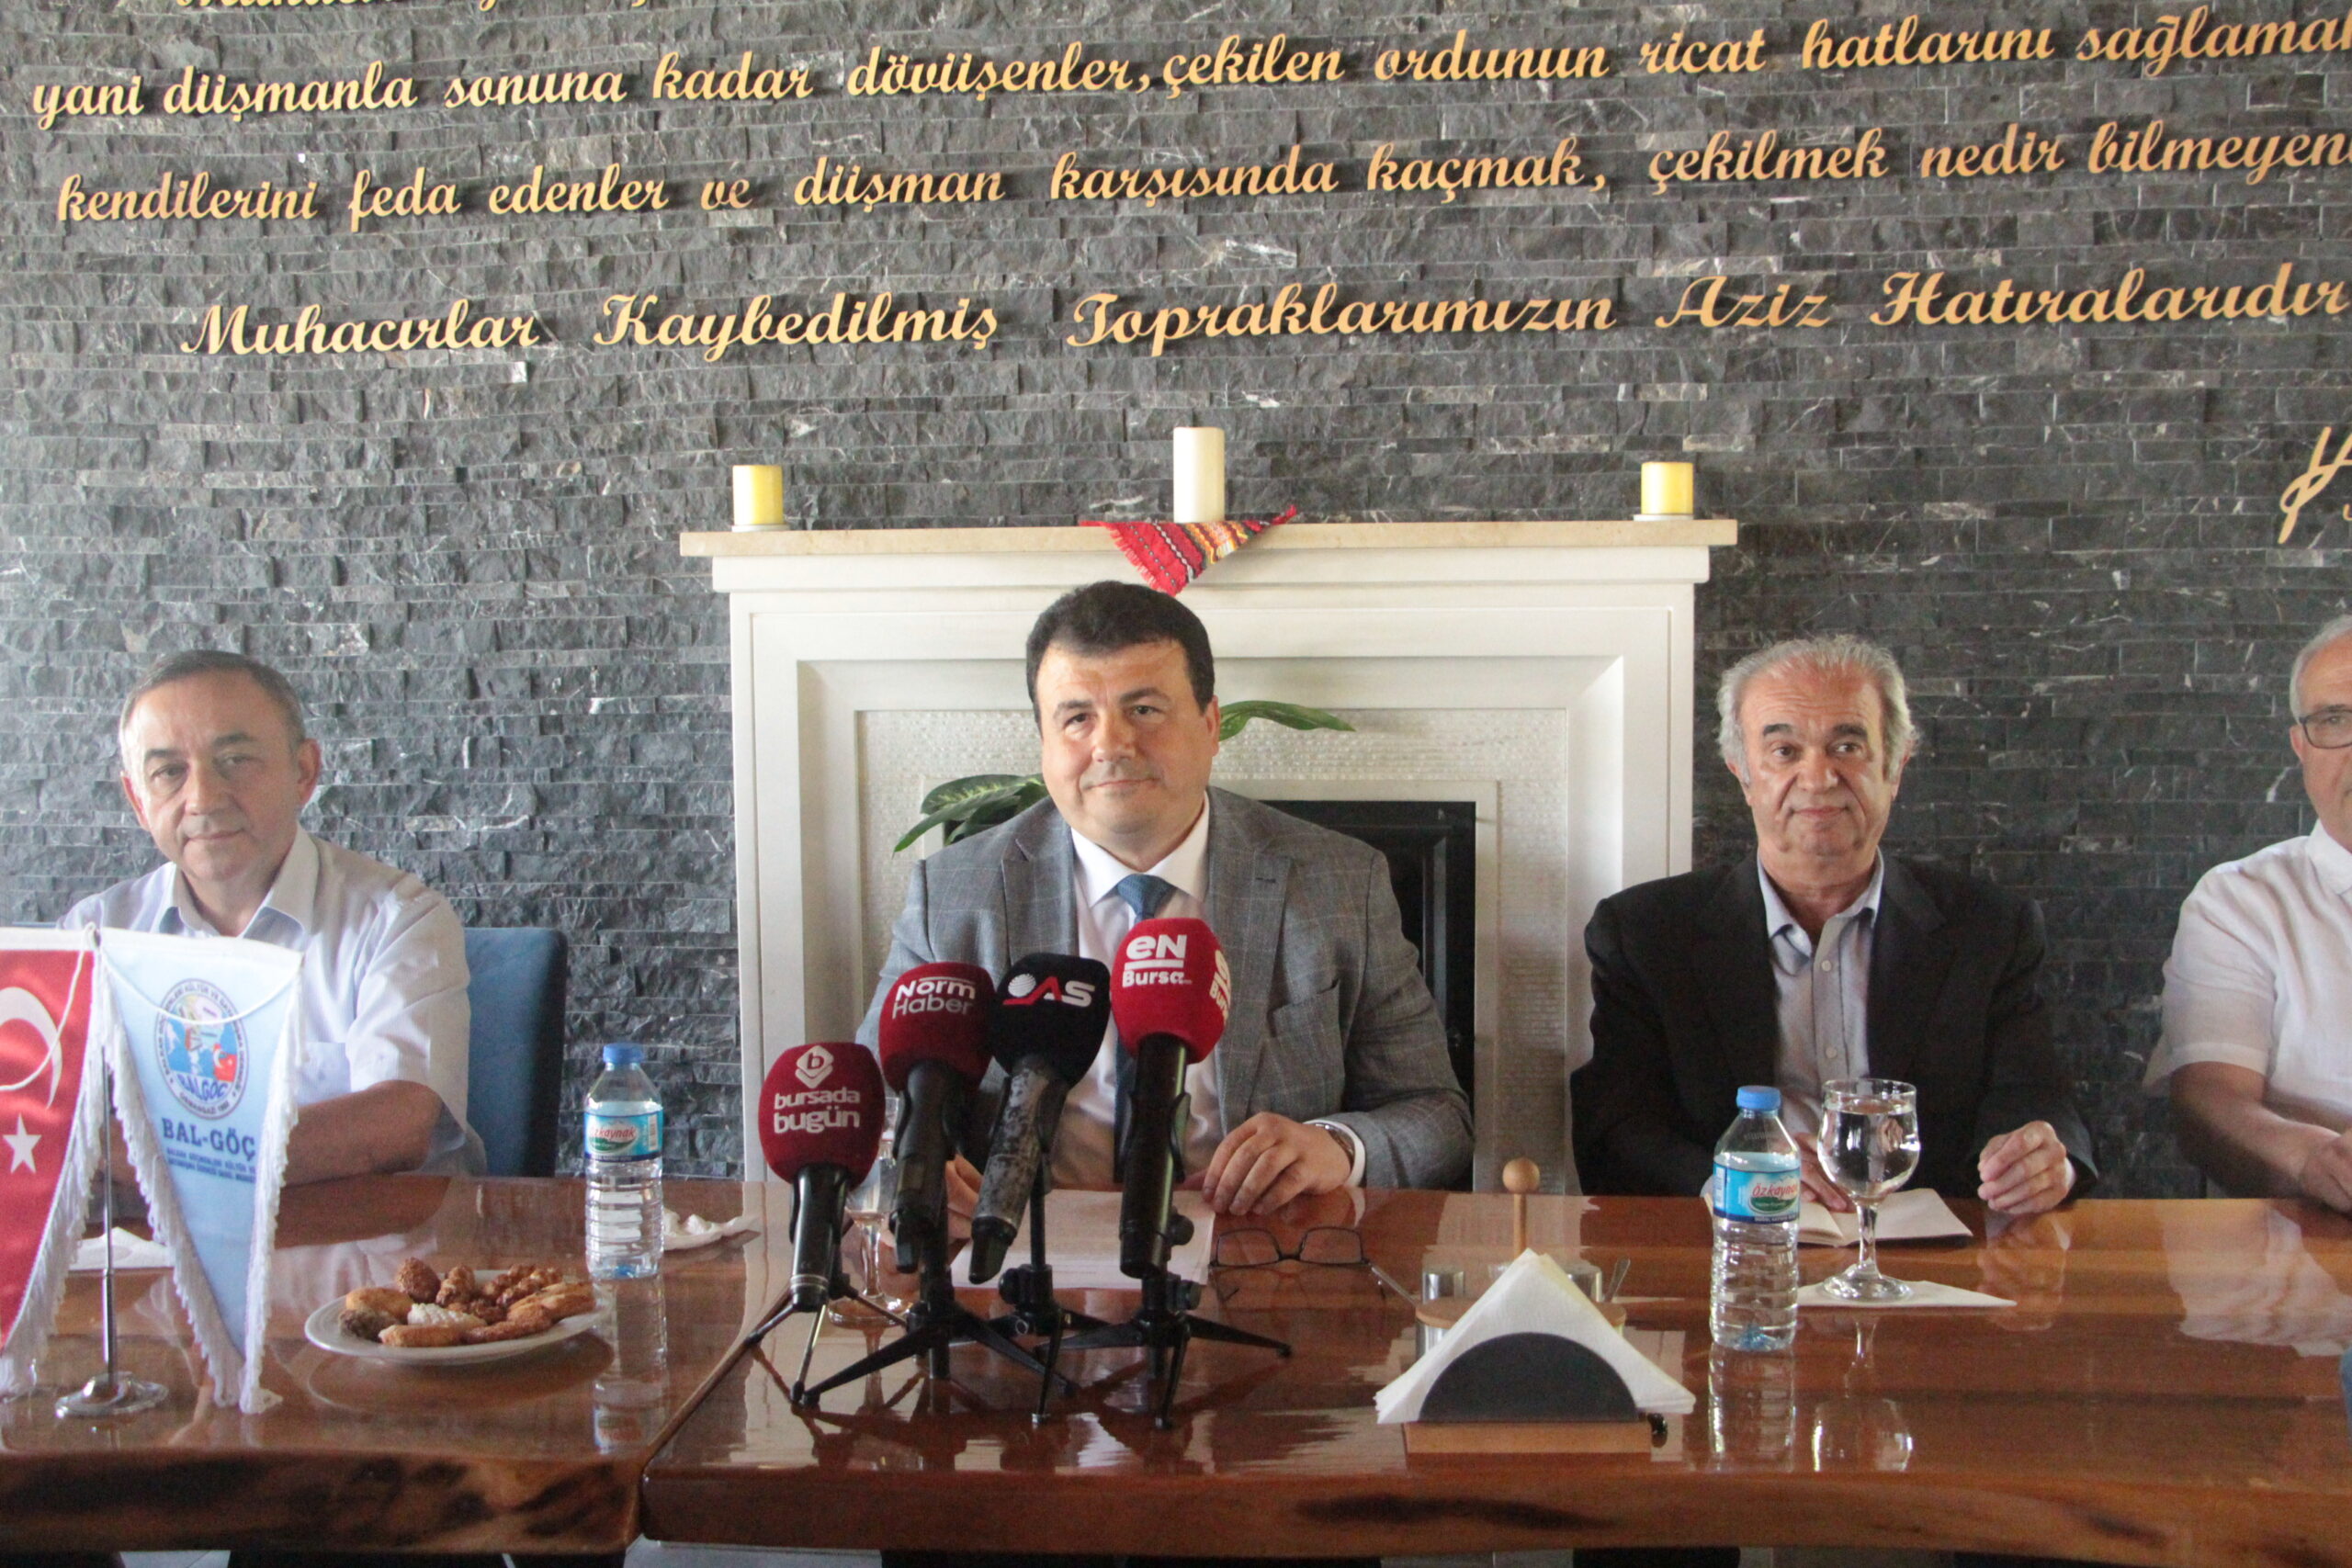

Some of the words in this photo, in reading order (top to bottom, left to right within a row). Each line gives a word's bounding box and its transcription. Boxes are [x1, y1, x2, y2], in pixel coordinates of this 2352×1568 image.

[32, 76, 144, 130] yani
[164, 61, 418, 122] düşmanla
[445, 72, 628, 107] sonuna
[651, 51, 813, 100] kadar
[847, 40, 1150, 101] dövüşenler,
[1162, 33, 1345, 99] çekilen
[1374, 28, 1610, 82] ordunun
[1639, 28, 1767, 74] ricat
[1802, 14, 2055, 69] hatlarını
[58, 171, 318, 221] kendilerini
[348, 166, 461, 232] feda
[489, 164, 669, 214] edenler
[700, 179, 750, 210] ve
[794, 157, 1005, 212] düşman
[1050, 145, 1339, 208] karşısında
[1366, 138, 1606, 204] kaçmak,
[1649, 128, 1888, 196] çekilmek
[1920, 123, 2065, 177] nedir
[2087, 119, 2352, 185] bilmeyen
[181, 299, 540, 355] Muhacırlar
[594, 292, 999, 362] Kaybedilmiş
[1067, 283, 1617, 357] Topraklarımızın
[1655, 275, 1830, 328] Aziz
[1870, 262, 2349, 327] Hatıralarıdır
[1126, 934, 1188, 960] eN
[895, 979, 976, 1001] Norm
[1122, 970, 1185, 988] Bursa
[892, 994, 974, 1020] Haber
[774, 1087, 861, 1110] bursada
[774, 1105, 861, 1134] bugün
[161, 1117, 256, 1162] BAL-GÖÇ
